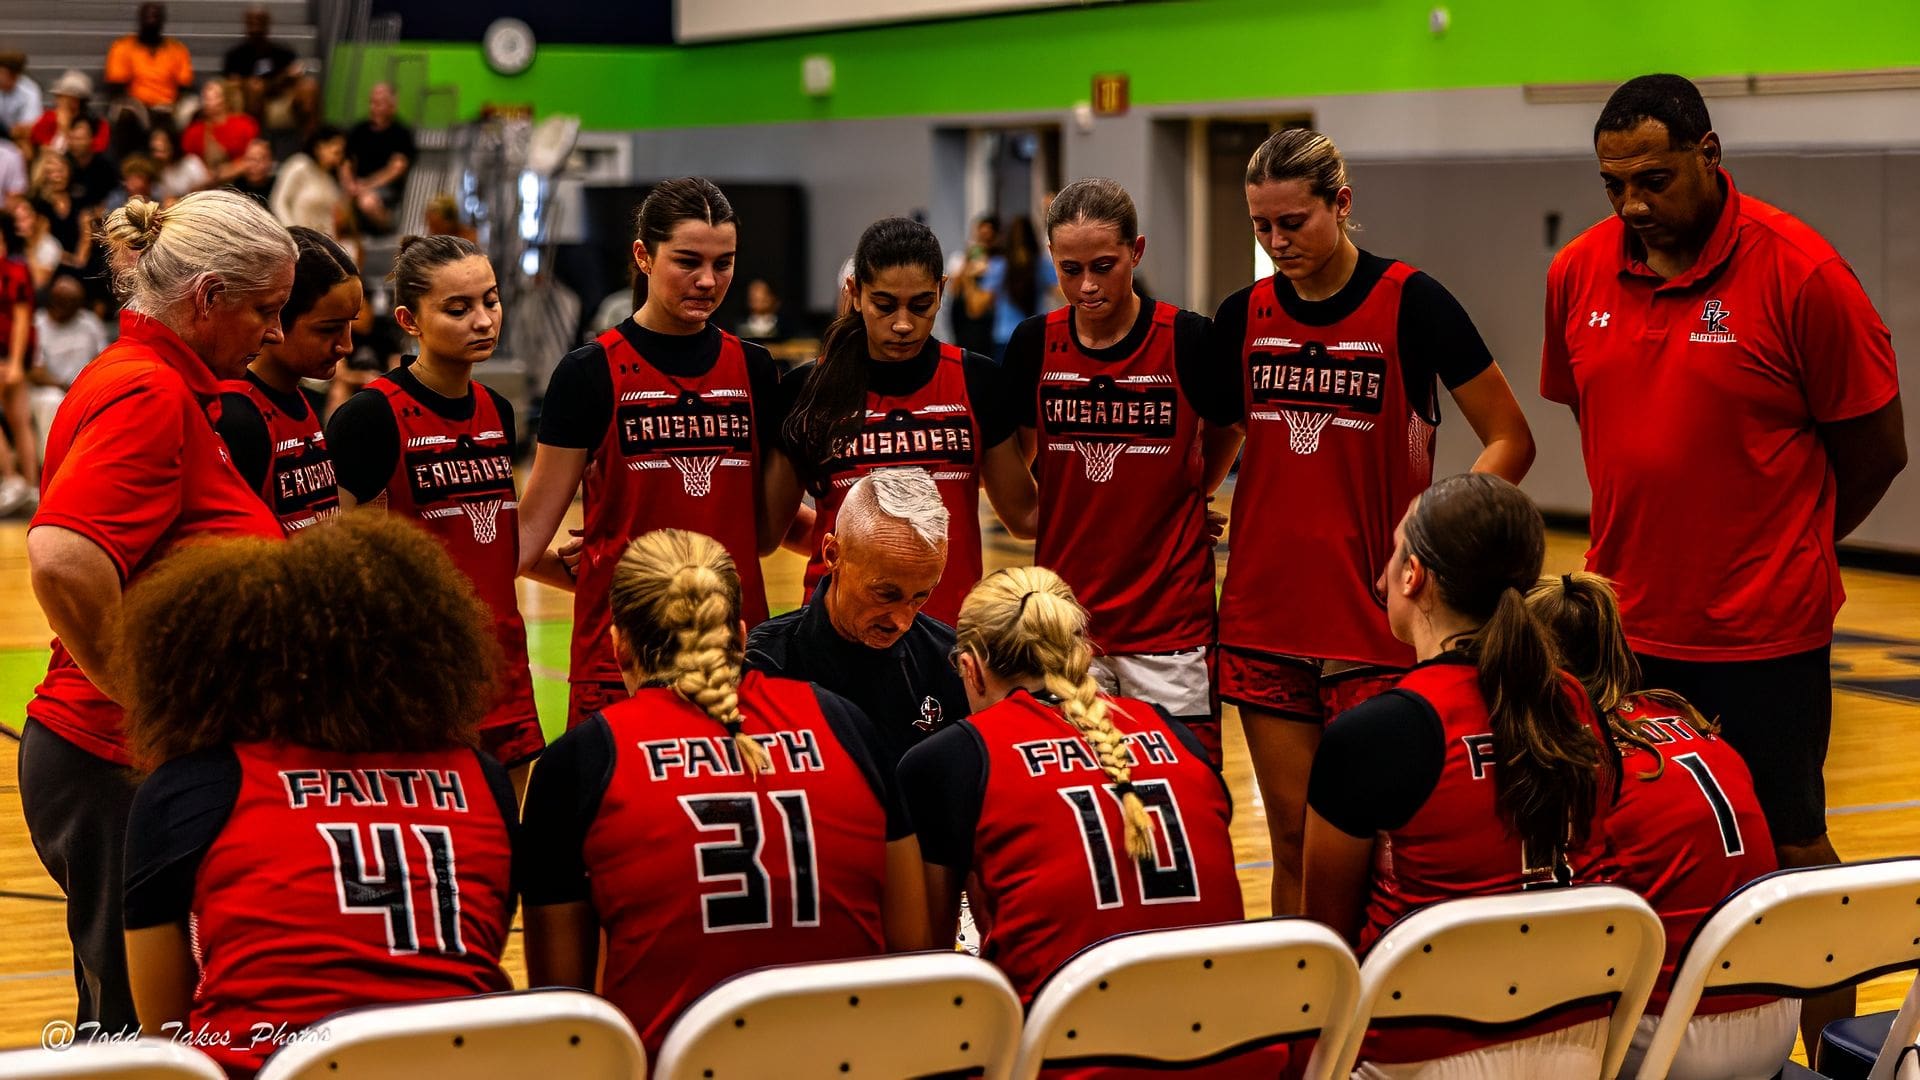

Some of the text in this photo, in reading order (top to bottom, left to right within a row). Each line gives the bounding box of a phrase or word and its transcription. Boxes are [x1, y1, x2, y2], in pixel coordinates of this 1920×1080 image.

[1252, 365, 1381, 399] CRUSADERS
[624, 414, 749, 442] CRUSADERS
[1045, 399, 1172, 425] CRUSADERS
[832, 427, 971, 459] RUSADERS
[278, 769, 469, 812] FAITH
[1670, 752, 1744, 857] 1
[677, 789, 820, 934] 31
[1057, 778, 1200, 910] 10
[316, 822, 467, 956] 41
